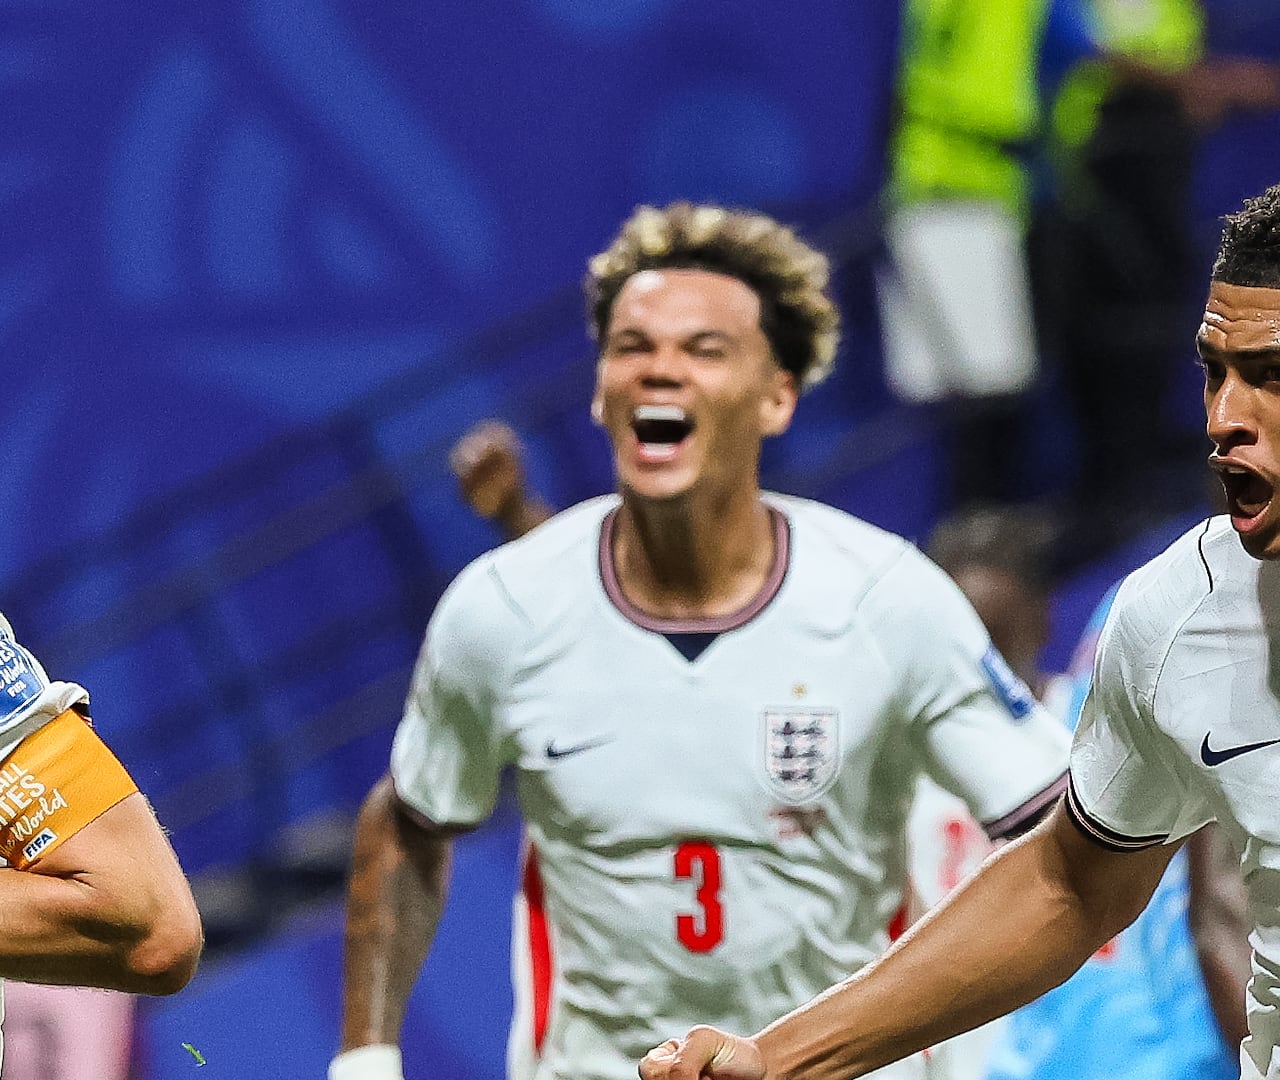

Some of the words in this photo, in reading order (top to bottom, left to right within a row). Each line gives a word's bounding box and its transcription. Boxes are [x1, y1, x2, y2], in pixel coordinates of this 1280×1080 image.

[9, 788, 69, 842] World
[25, 833, 53, 858] FIFA
[674, 841, 725, 954] 3
